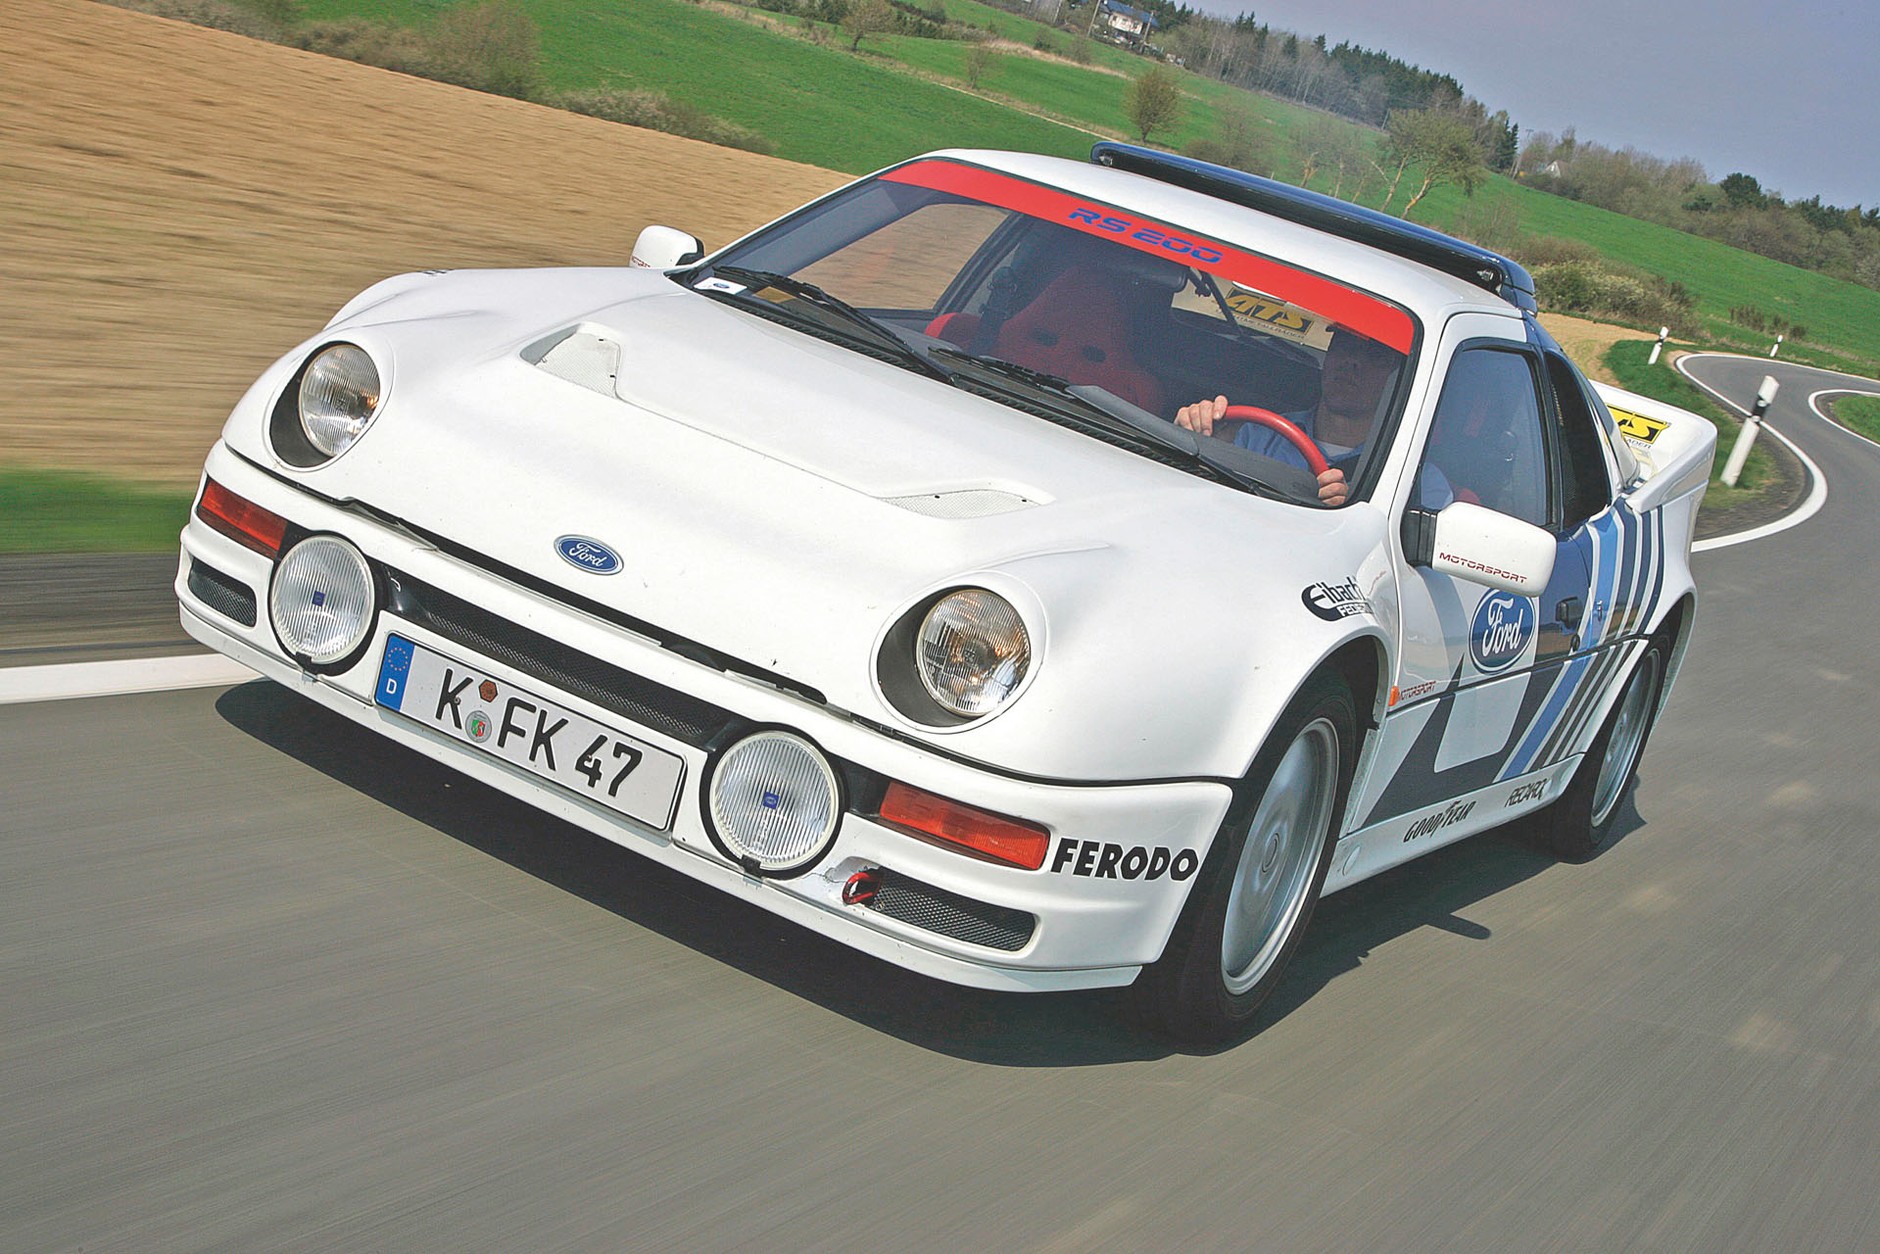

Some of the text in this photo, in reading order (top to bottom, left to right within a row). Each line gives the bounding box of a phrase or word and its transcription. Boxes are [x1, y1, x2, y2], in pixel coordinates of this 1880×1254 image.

[1068, 207, 1224, 264] RS 200
[1225, 293, 1304, 330] ATS
[568, 542, 608, 567] Ford
[1439, 552, 1528, 584] MOTORSPORT
[1301, 576, 1367, 622] Eibach
[1481, 597, 1524, 658] Ford
[386, 678, 398, 695] D
[435, 668, 643, 798] K FK 47
[1402, 799, 1477, 843] GOODYEAR
[1051, 837, 1199, 882] FERODO
